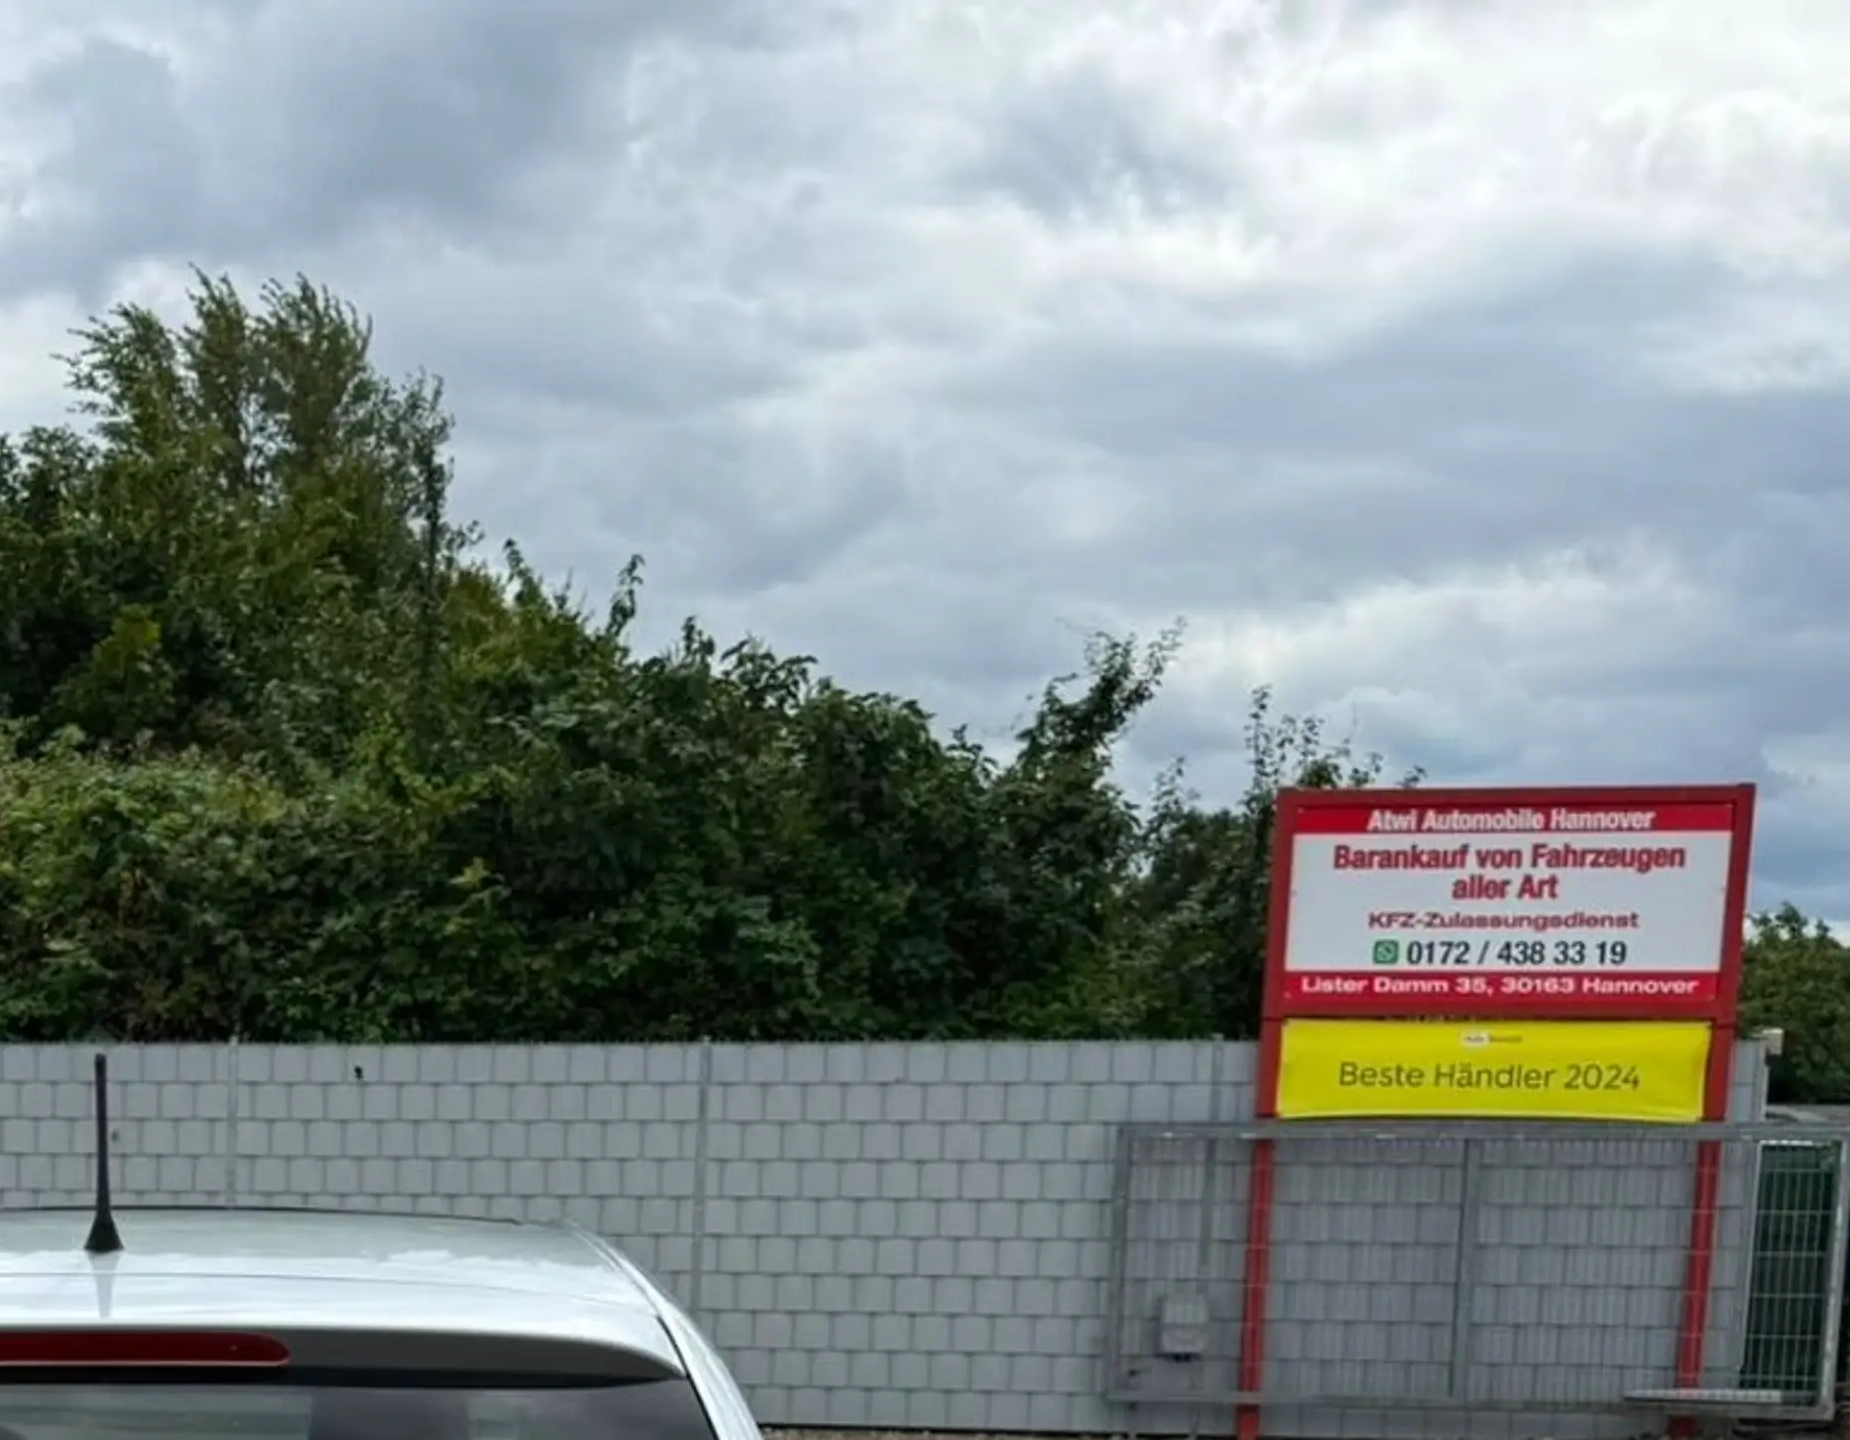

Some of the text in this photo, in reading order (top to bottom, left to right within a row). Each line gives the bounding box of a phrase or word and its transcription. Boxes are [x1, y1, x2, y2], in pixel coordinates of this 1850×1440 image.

[1367, 807, 1657, 831] Atwi Automobile Hannover
[1333, 843, 1686, 873] Barankauf von Fahrzeugen
[1452, 874, 1558, 900] aller Art
[1367, 911, 1639, 931] KFZ-Zulassungsdienst
[1406, 940, 1471, 966] 0172
[1496, 940, 1546, 966] 438
[1552, 940, 1586, 966] 33
[1596, 940, 1628, 966] 19
[1302, 976, 1700, 998] Lister Damm 35, 30163 Hannover
[1338, 1061, 1640, 1090] Beste Händler 2024
